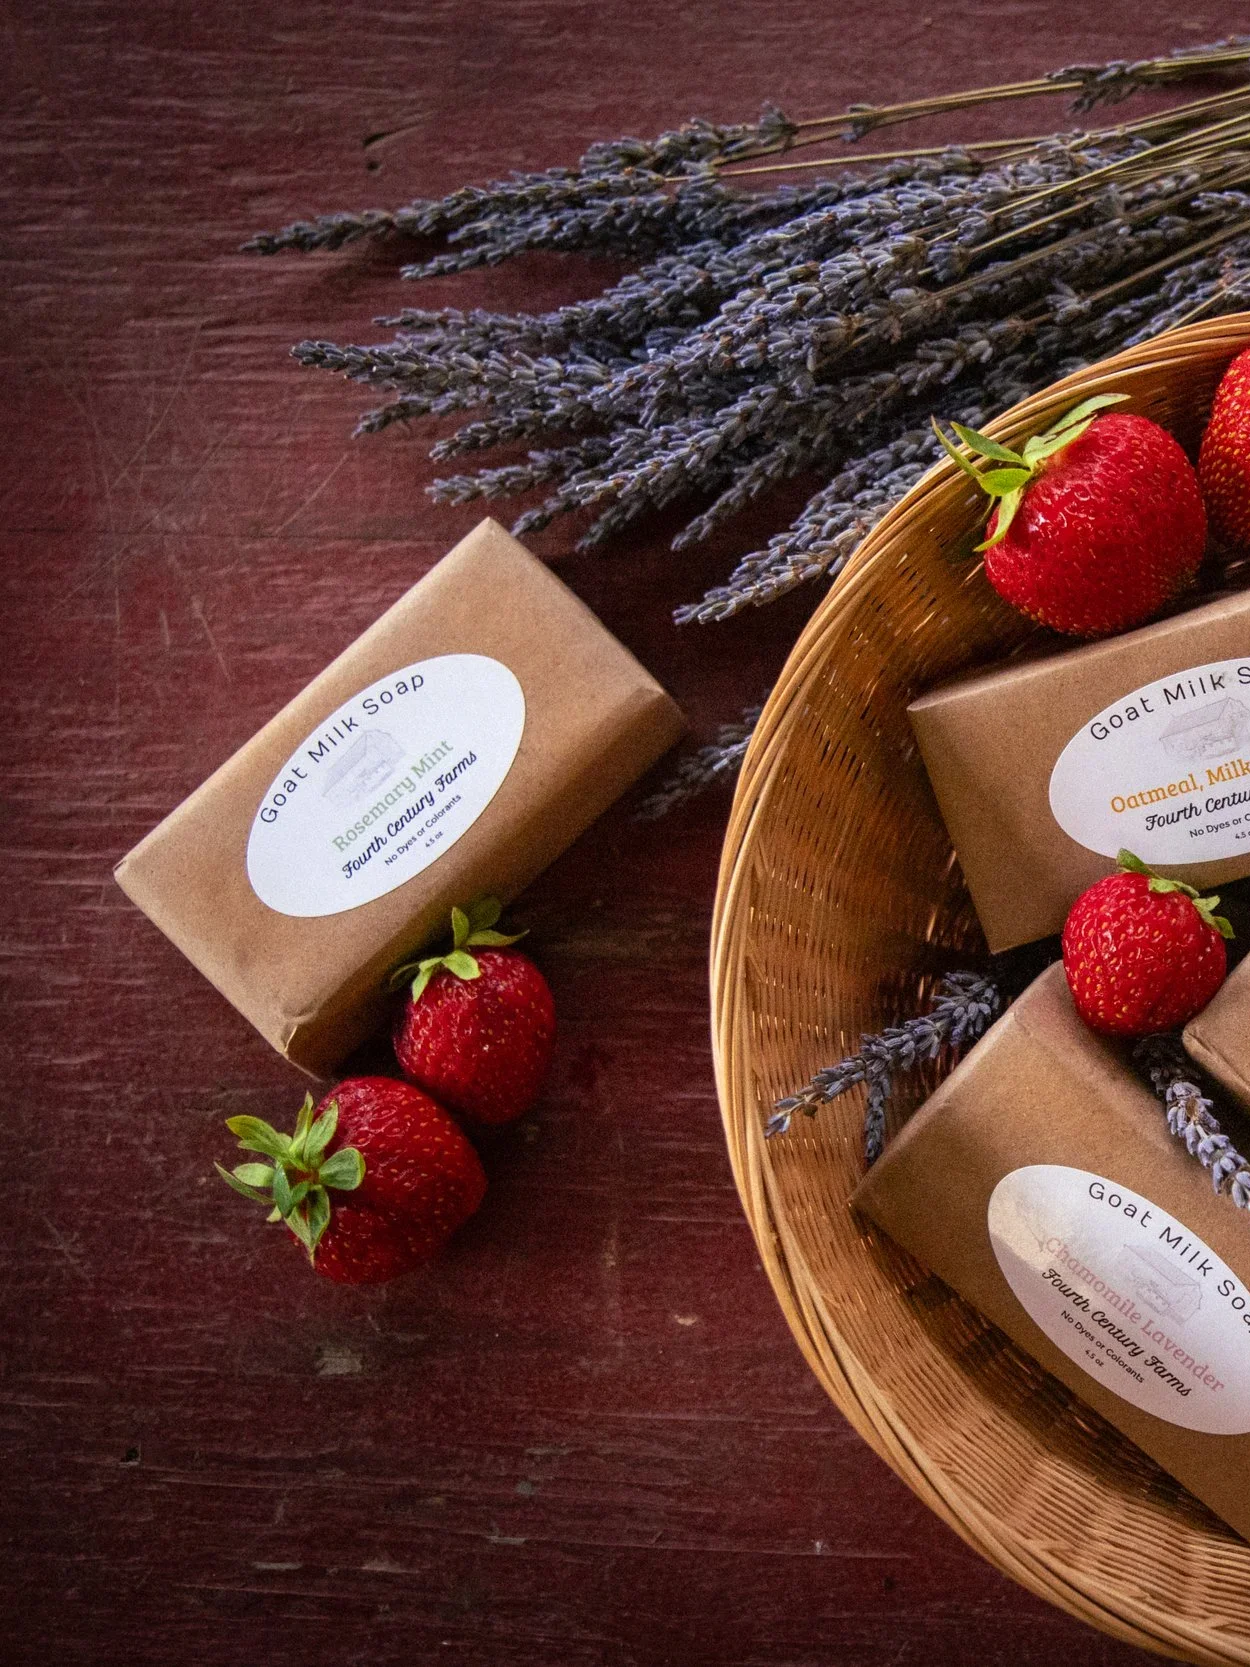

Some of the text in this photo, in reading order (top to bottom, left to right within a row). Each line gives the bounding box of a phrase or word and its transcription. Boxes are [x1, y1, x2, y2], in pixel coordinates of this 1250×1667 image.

[1090, 696, 1154, 740] Goat
[1163, 673, 1226, 705] Milk
[260, 673, 424, 824] Goat Milk Soap
[331, 740, 454, 852] Rosemary Mint
[341, 750, 477, 879] Fourth Century Farms
[385, 794, 462, 866] No Dyes or Colorants
[1110, 774, 1204, 814] Oatmeal,
[1145, 802, 1202, 831] Fourth
[1189, 827, 1204, 838] No
[1206, 820, 1230, 835] Dyes
[1232, 815, 1243, 824] or
[425, 831, 444, 848] 4.5 oz
[1235, 832, 1246, 840] 4.5
[1089, 1182, 1153, 1228] Goat
[1159, 1227, 1214, 1277] Milk
[1042, 1268, 1192, 1397] Fourth Century Farms
[1046, 1237, 1225, 1393] Chamomile Lavender
[1061, 1310, 1145, 1383] No Dyes or Colorants
[1085, 1349, 1104, 1368] 4.5 oz
